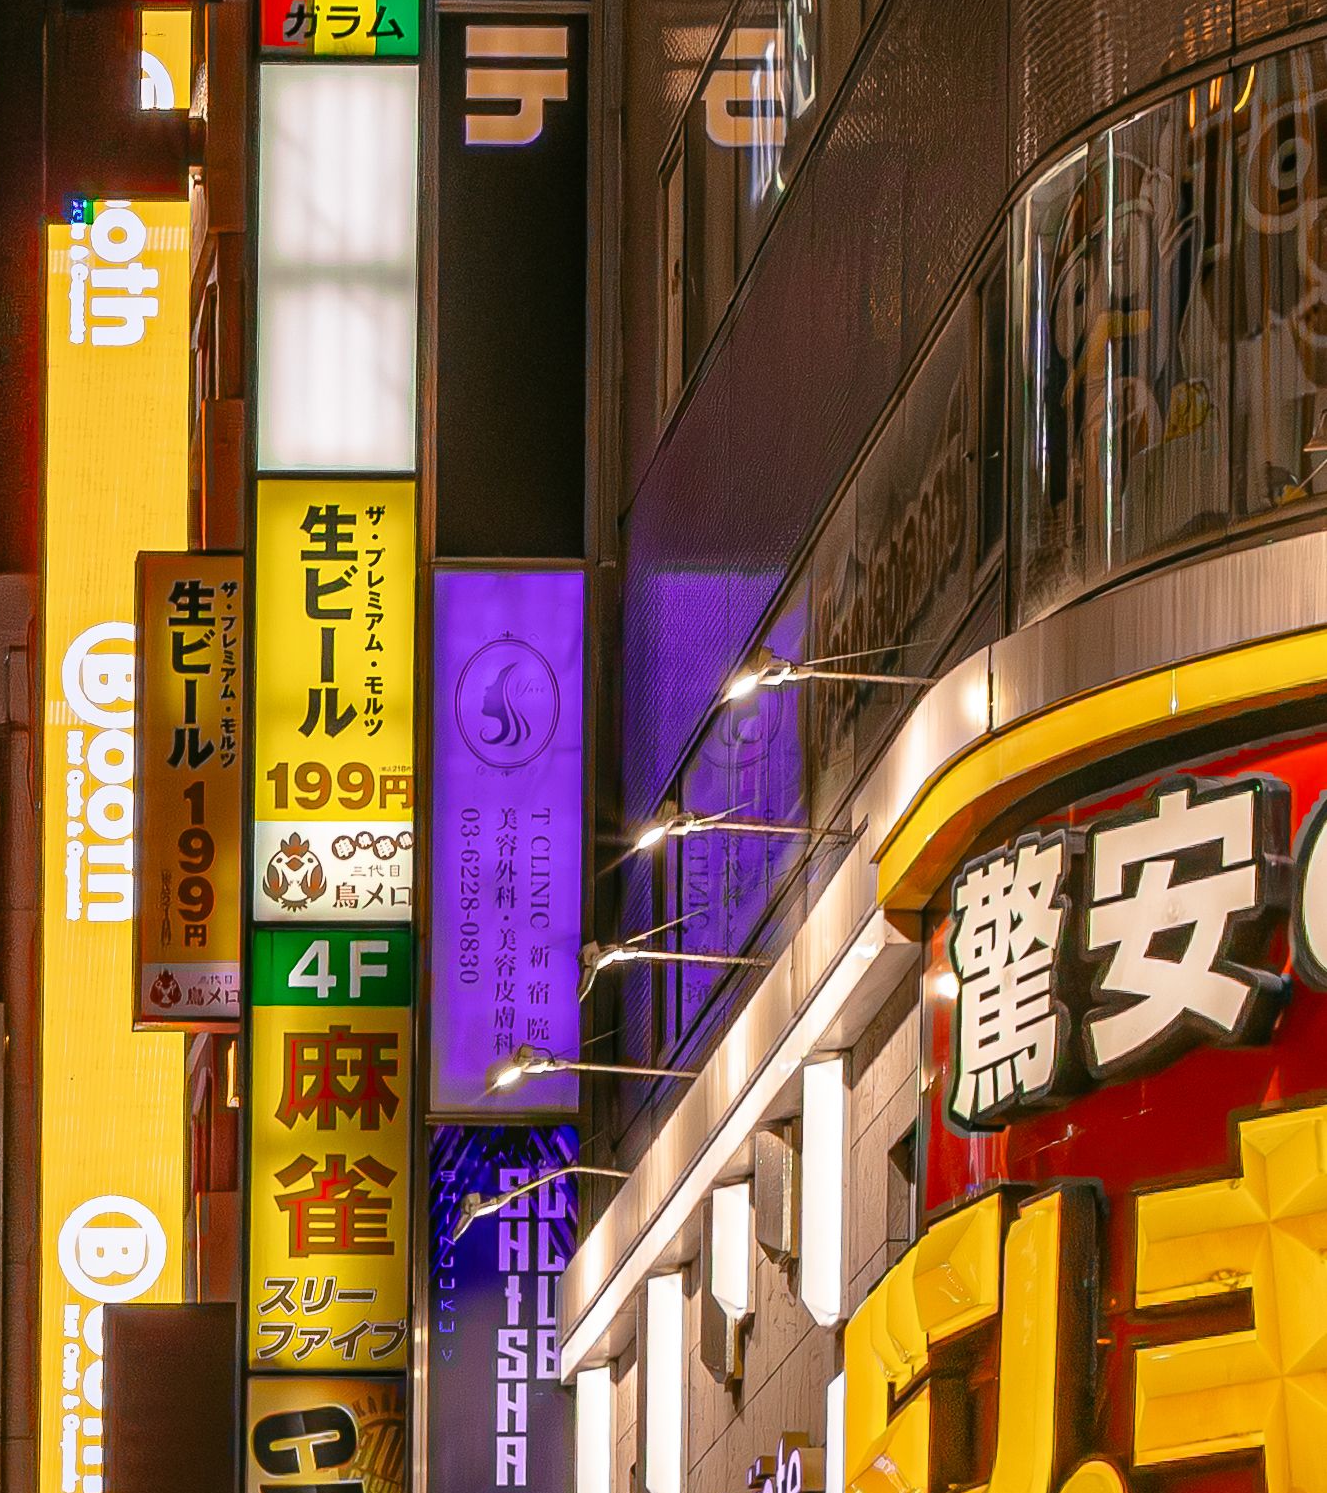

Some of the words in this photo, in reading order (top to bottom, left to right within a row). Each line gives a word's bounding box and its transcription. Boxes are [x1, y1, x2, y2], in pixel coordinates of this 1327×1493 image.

[283, 5, 406, 42] ガラム
[298, 503, 359, 741] 生ビール
[361, 505, 386, 739] ザ・プレミアム・モルツ
[166, 579, 217, 771] 生ビール
[265, 761, 414, 812] 199円
[178, 780, 217, 948] 199円
[332, 880, 412, 911] 鳥メロ
[350, 863, 401, 879] 三代目
[459, 808, 481, 984] 03-6228-0830
[530, 835, 551, 930] CLINIC
[286, 939, 391, 1000] 4F
[271, 1025, 401, 1261] 麻雀
[256, 1275, 379, 1316] スリー
[254, 1319, 409, 1364] ファイブ
